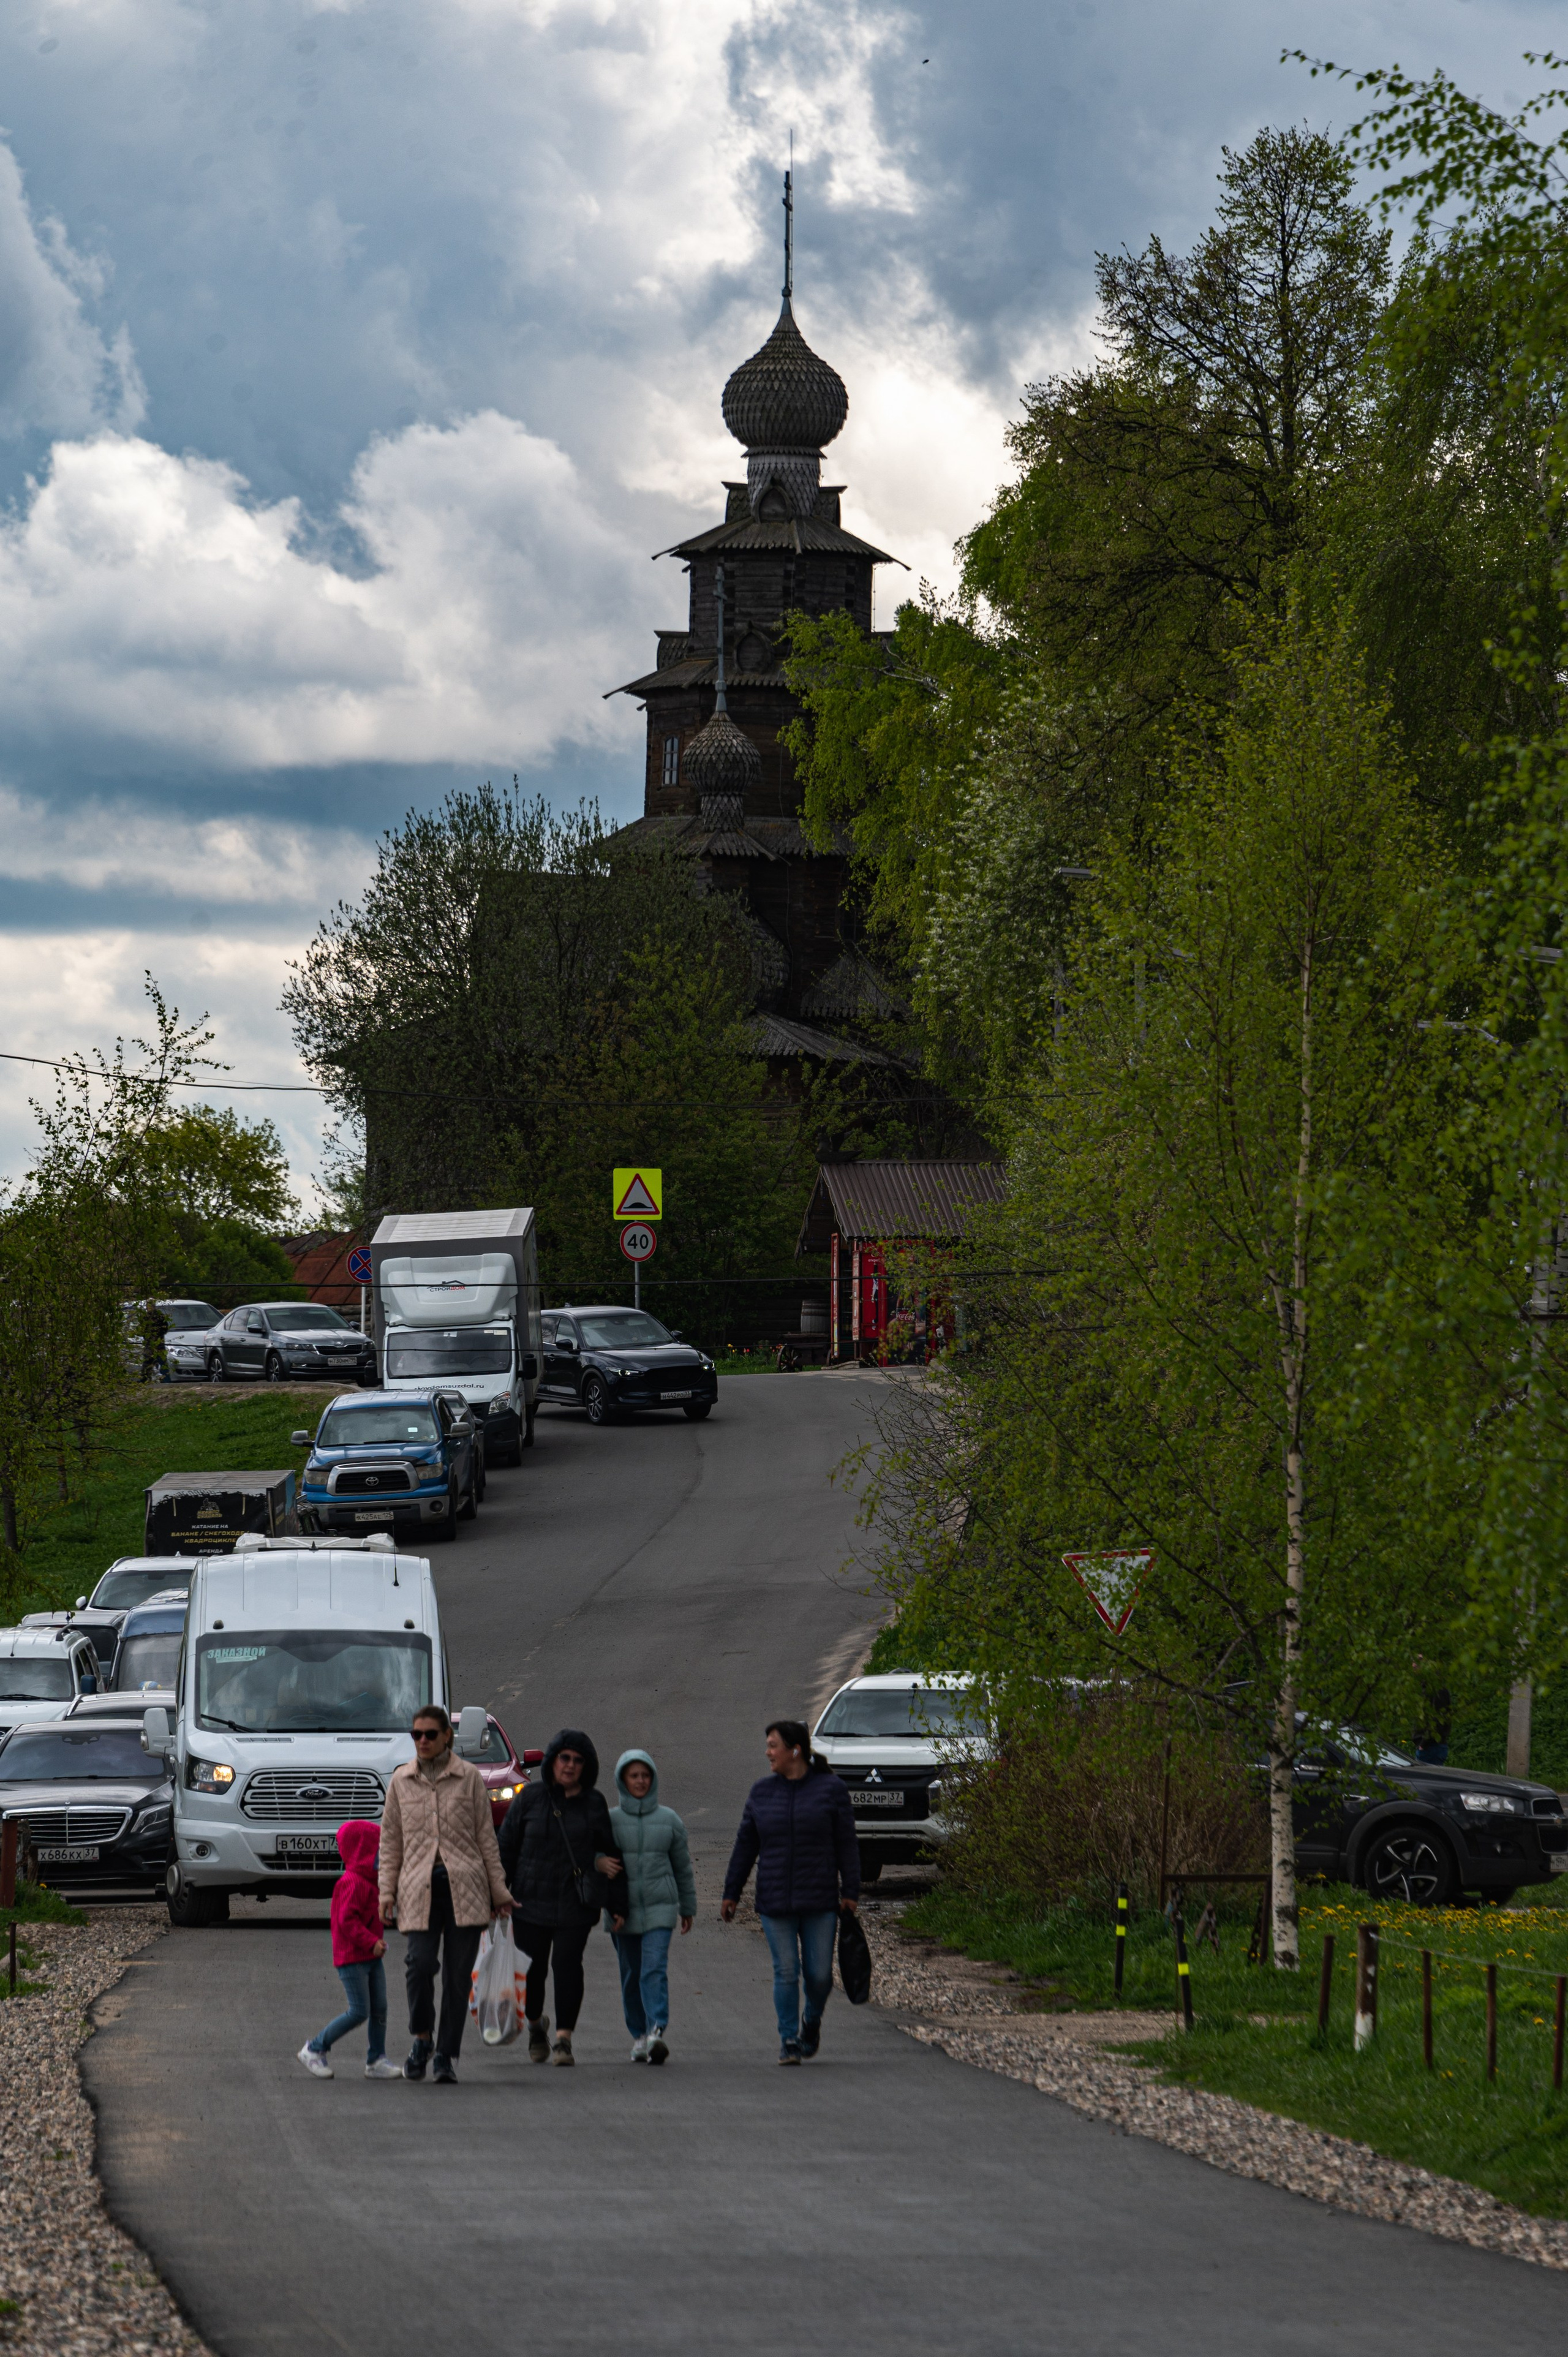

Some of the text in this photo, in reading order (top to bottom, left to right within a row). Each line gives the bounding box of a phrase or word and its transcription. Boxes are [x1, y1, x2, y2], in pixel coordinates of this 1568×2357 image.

[627, 1234, 649, 1250] 40
[207, 1646, 267, 1659] ЗАКАЗНОЙ
[853, 1792, 887, 1803] 682МР
[281, 1837, 328, 1850] В160ХТ
[40, 1848, 96, 1860] Х686КХ 37
